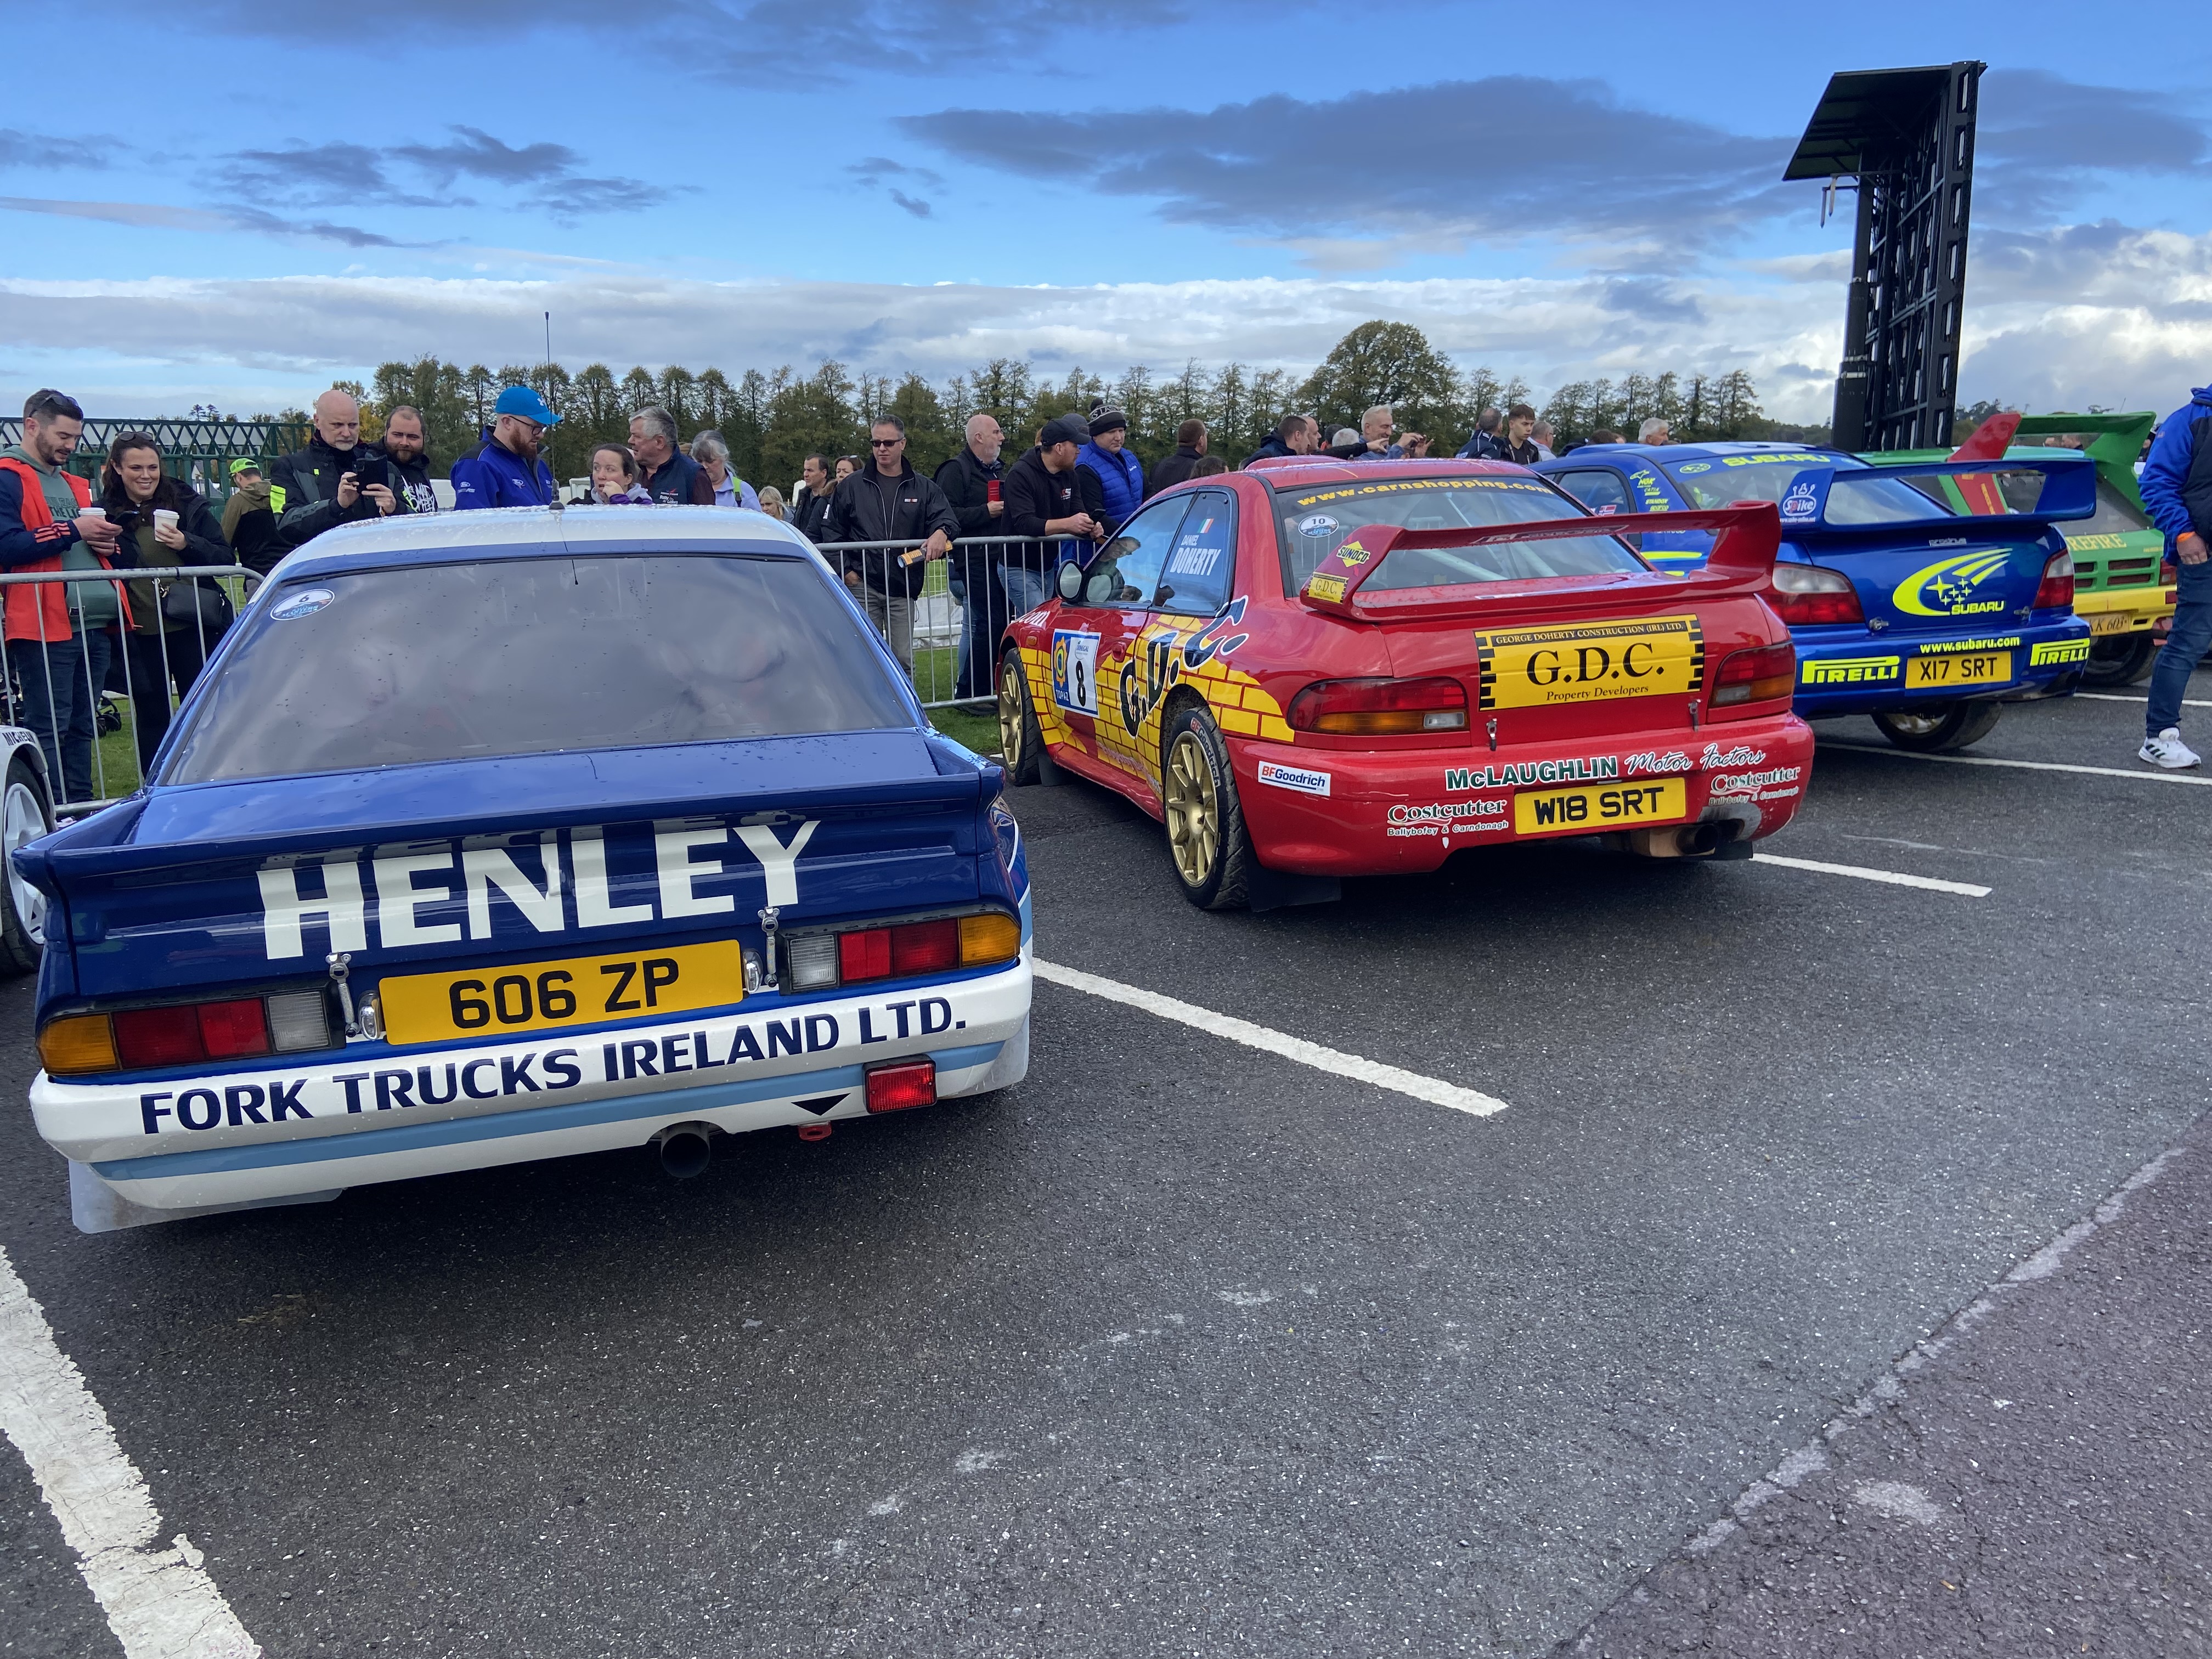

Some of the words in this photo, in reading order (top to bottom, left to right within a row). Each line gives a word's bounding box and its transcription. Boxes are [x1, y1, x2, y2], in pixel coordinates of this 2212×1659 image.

[1723, 454, 1830, 466] SUBARU
[1297, 479, 1554, 506] www.carnshopping.com
[1785, 498, 1814, 514] Spike
[1181, 535, 1200, 546] DANIEL
[2065, 533, 2127, 551] REFIRE
[1170, 547, 1222, 575] DOHERTY
[1338, 546, 1369, 563] SUNOCO
[299, 594, 310, 603] 6
[1316, 579, 1337, 595] G.D.C.
[1951, 600, 2005, 616] SUBARU
[1496, 634, 1533, 645] GEORGE
[1533, 631, 1575, 642] DOHERTY
[1577, 625, 1645, 639] CONSTRUCTION
[1646, 624, 1665, 633] (IRL)
[1666, 622, 1684, 631] LTD.
[1920, 636, 2021, 654] www.subaru.com
[2030, 637, 2090, 667] PIRELLI
[1526, 642, 1664, 686] G.D.C.
[1802, 656, 1900, 684] PIRELLI
[1920, 659, 1949, 681] X17
[1961, 657, 1997, 678] SRT
[1075, 660, 1086, 707] 8
[1545, 690, 1591, 702] Property
[1594, 685, 1649, 697] Developers
[1056, 689, 1069, 702] TOPAZ
[1262, 765, 1325, 787] BFGoodrich
[1446, 756, 1618, 791] McLAUGHLIN
[1624, 751, 1692, 775] Motor
[1700, 742, 1766, 770] Factors
[1711, 766, 1801, 792] Costcutter
[1534, 795, 1588, 825] W18
[1600, 787, 1664, 818] SRT
[1751, 793, 1758, 802] &
[1387, 799, 1506, 825] Costcutter
[1387, 825, 1438, 837] Ballybofey
[1441, 825, 1448, 834] &
[1452, 820, 1509, 833] Carndonagh
[256, 821, 820, 960] HENLEY
[449, 969, 577, 1029] 606
[600, 957, 679, 1012] ZP
[140, 1079, 314, 1135] FORK
[333, 1048, 582, 1115] TRUCKS
[603, 1013, 839, 1082] IRELAND
[858, 996, 966, 1044] LTD.
